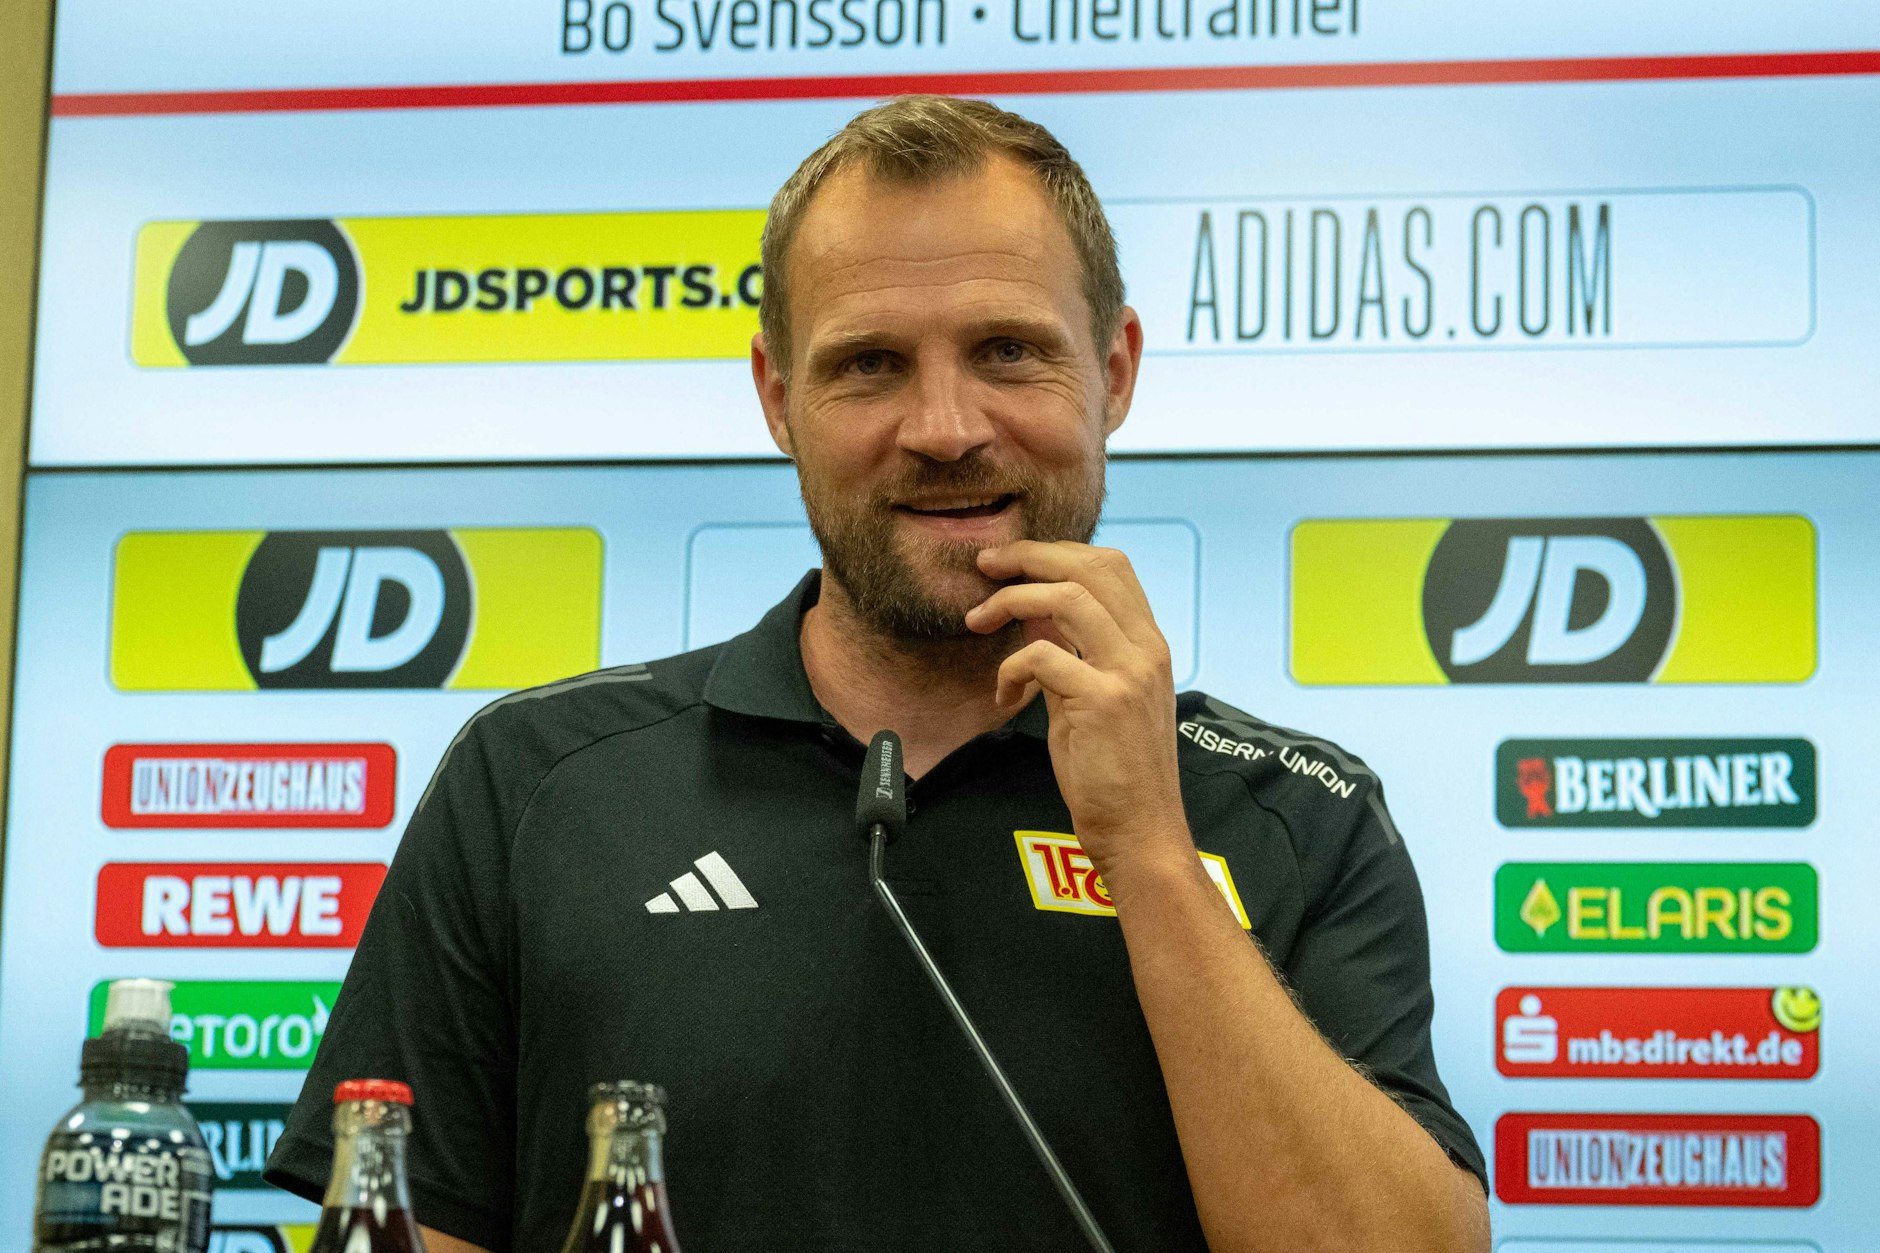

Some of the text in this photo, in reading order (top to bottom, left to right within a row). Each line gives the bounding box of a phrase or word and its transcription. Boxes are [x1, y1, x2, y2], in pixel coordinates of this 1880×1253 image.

[562, 0, 632, 53] Bo
[654, 0, 946, 51] Svensson
[184, 240, 340, 346] JD
[1187, 202, 1612, 342] ADIDAS.COM
[259, 546, 447, 673] JD
[1450, 535, 1647, 666] JD
[1279, 746, 1357, 799] UNION
[1554, 751, 1799, 818] BERLINER
[141, 876, 343, 936] REWE
[1567, 886, 1794, 940] ELARIS
[1567, 1030, 1803, 1067] mbsdirekt.de
[46, 1149, 180, 1187] POWER
[101, 1183, 181, 1221] ADE
